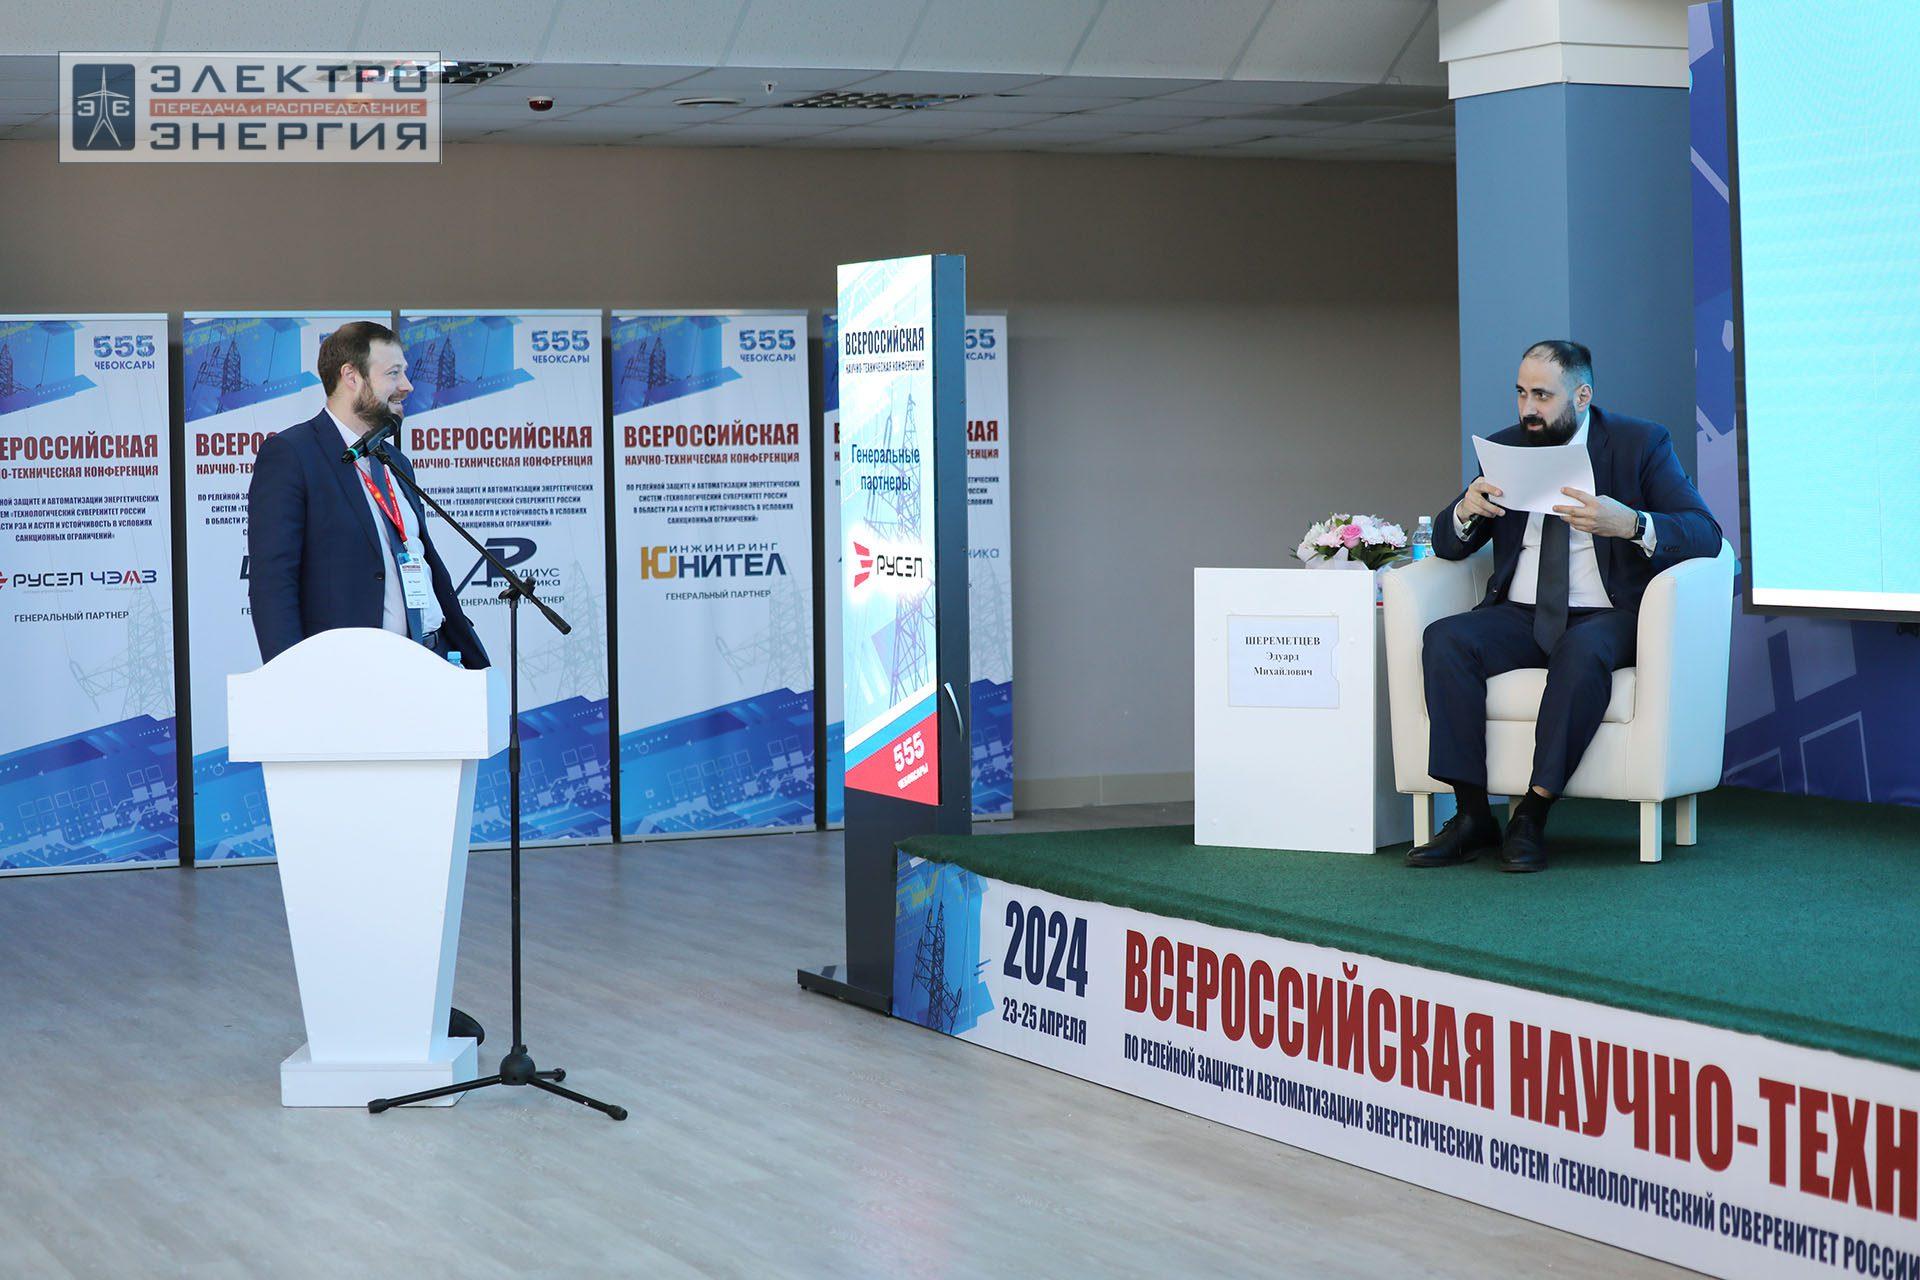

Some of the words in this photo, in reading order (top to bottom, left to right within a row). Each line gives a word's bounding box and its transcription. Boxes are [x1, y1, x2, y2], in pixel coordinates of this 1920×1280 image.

[531, 330, 590, 351] 555
[739, 330, 796, 350] 555
[845, 325, 925, 355] ВСЕРОССИЙСКАЯ
[93, 335, 156, 358] 555
[532, 355, 590, 363] ЧЕБОКСАРЫ
[740, 354, 796, 362] ЧЕБОКСАРЫ
[94, 361, 155, 370] ЧЕБОКСАРЫ
[411, 422, 593, 451] ВСЕРОССИЙСКАЯ
[623, 420, 799, 448] ВСЕРОССИЙСКАЯ
[195, 432, 278, 457] ВСЕРО
[412, 456, 520, 469] НАУЧНО-ТЕХНИЧЕСКАЯ
[522, 455, 593, 468] КОНФЕРЕНЦИЯ
[624, 453, 728, 466] НАУЧНО-ТЕХНИЧЕСКАЯ
[730, 452, 800, 465] КОНФЕРЕНЦИЯ
[851, 444, 921, 468] Генеральные
[0, 466, 82, 480] О-ТЕХНИЧЕСКАЯ
[84, 465, 159, 478] КОНФЕРЕНЦИЯ
[455, 486, 481, 495] ЗАЩИТЕ
[487, 485, 541, 494] АВТОМАТИЗАЦИИ
[541, 484, 594, 492] ЭНЕРГЕТИЧЕСКИХ
[635, 482, 665, 491] РЕЛЕЙНОЙ
[666, 482, 690, 490] ЗАЩИТЕ
[697, 481, 748, 490] АВТОМАТИЗАЦИИ
[749, 480, 800, 488] ЭНЕРГЕТИЧЕСКИХ
[861, 475, 911, 495] партнеры
[13, 497, 40, 506] ЗАЩИТЕ
[42, 497, 46, 505] И
[47, 495, 103, 505] АВТОМАТИЗАЦИИ
[104, 494, 160, 504] ЭНЕРГЕТИЧЕСКИХ
[197, 493, 206, 501] ПО
[207, 492, 240, 501] РЕЛЕЙНОЙ
[515, 496, 555, 504] СУВЕРЕНИТЕТ
[638, 494, 662, 502] СИСТЕМ
[722, 492, 762, 500] СУВЕРЕНИТЕТ
[76, 507, 118, 517] СУВЕРЕНИТЕТ
[119, 506, 146, 515] РОССИИ
[500, 507, 549, 516] УСТОЙЧИВОСТЬ
[555, 507, 587, 515] УСЛОВИЯХ
[709, 503, 756, 512] УСТОЙЧИВОСТЬ
[762, 502, 794, 511] УСЛОВИЯХ
[0, 522, 13, 530] СТИ
[28, 521, 33, 529] И
[33, 521, 55, 529] АСУТП
[56, 520, 60, 528] И
[61, 518, 111, 529] УСТОЙЧИВОСТЬ
[112, 519, 117, 527] В
[118, 518, 152, 527] УСЛОВИЯХ
[205, 517, 210, 525] В
[211, 517, 241, 525] ОБЛАСТИ
[667, 516, 713, 524] САНКЦИОННЫХ
[15, 533, 66, 542] САНКЦИОННЫХ
[669, 542, 779, 554] ИНЖИНИРИНГ
[641, 545, 787, 580] ЮНИТЕЛ
[665, 589, 728, 600] ГЕНЕРАЛЬНЫЙ
[730, 589, 772, 599] ПАРТНЕР
[14, 611, 84, 623] ГЕНЕРАЛЬНЫЙ
[86, 611, 129, 621] ПАРТНЕР
[1245, 636, 1321, 646] ШЕРЕМЕТЦЕВ
[1266, 651, 1300, 662] Эдуард
[1254, 666, 1313, 676] Михайлович
[893, 731, 925, 772] 555
[1003, 900, 1089, 998] 2024
[1002, 997, 1037, 1031] 23-25
[1039, 1007, 1087, 1046] АПРЕЛЯ
[1124, 929, 1494, 1111] ВСЕРОССИЙСКАЯ
[1509, 1020, 1919, 1222] НАУЧНО-ТЕХН
[1124, 1033, 1139, 1062] ПО
[1140, 1040, 1196, 1079] РЕЛЕЙНОЙ
[1197, 1054, 1244, 1093] ЗАЩИТЕ
[1246, 1069, 1254, 1096] И
[1256, 1071, 1364, 1129] АВТОМАТИЗАЦИИ
[1366, 1103, 1484, 1165] ЭНЕРГЕТИЧЕСКИХ
[1490, 1138, 1549, 1184] СИСТЕМ
[1553, 1157, 1715, 1231] «ТЕХНОЛОГИЧЕСКИЙ
[1719, 1202, 1839, 1266] СУВЕРЕНИТЕТ
[1843, 1235, 1920, 1280] РОССИИ
